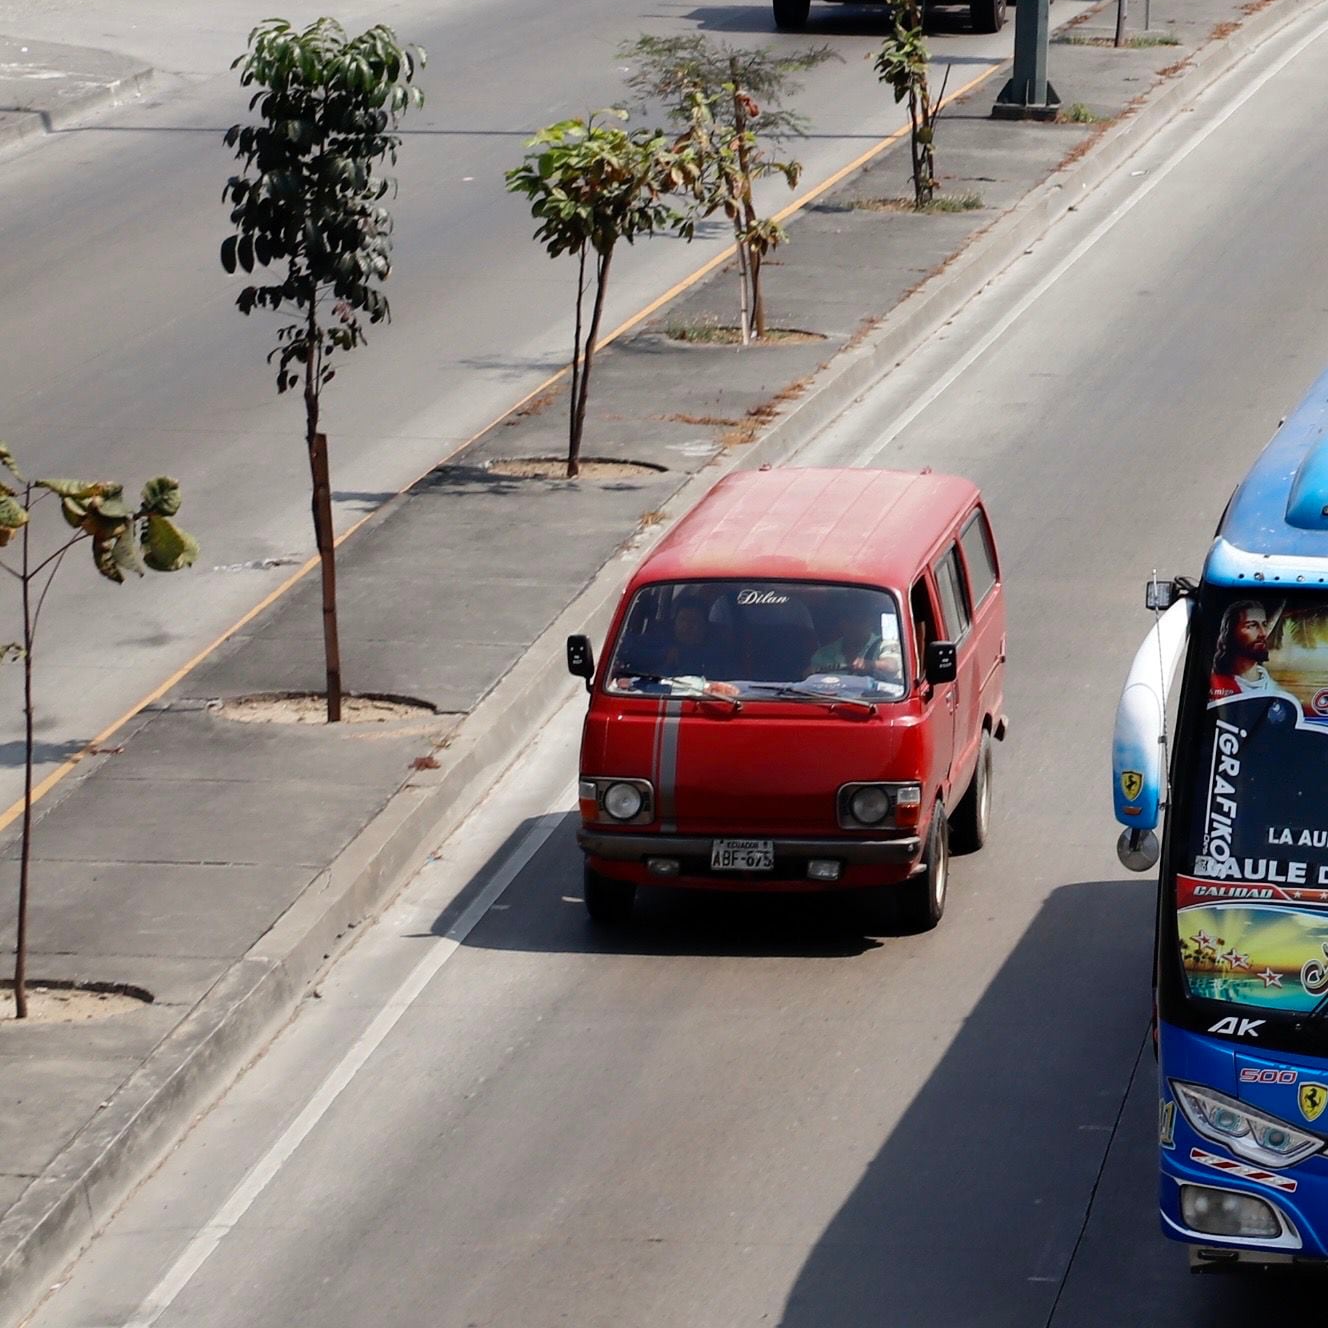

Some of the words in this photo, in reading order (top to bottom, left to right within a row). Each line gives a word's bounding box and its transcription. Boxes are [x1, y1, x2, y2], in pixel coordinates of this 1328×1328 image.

[737, 589, 790, 605] Dilan
[1268, 827, 1293, 845] LA
[1193, 885, 1274, 899] CALIDAD
[1207, 1016, 1267, 1037] AK
[1239, 1068, 1299, 1085] 500
